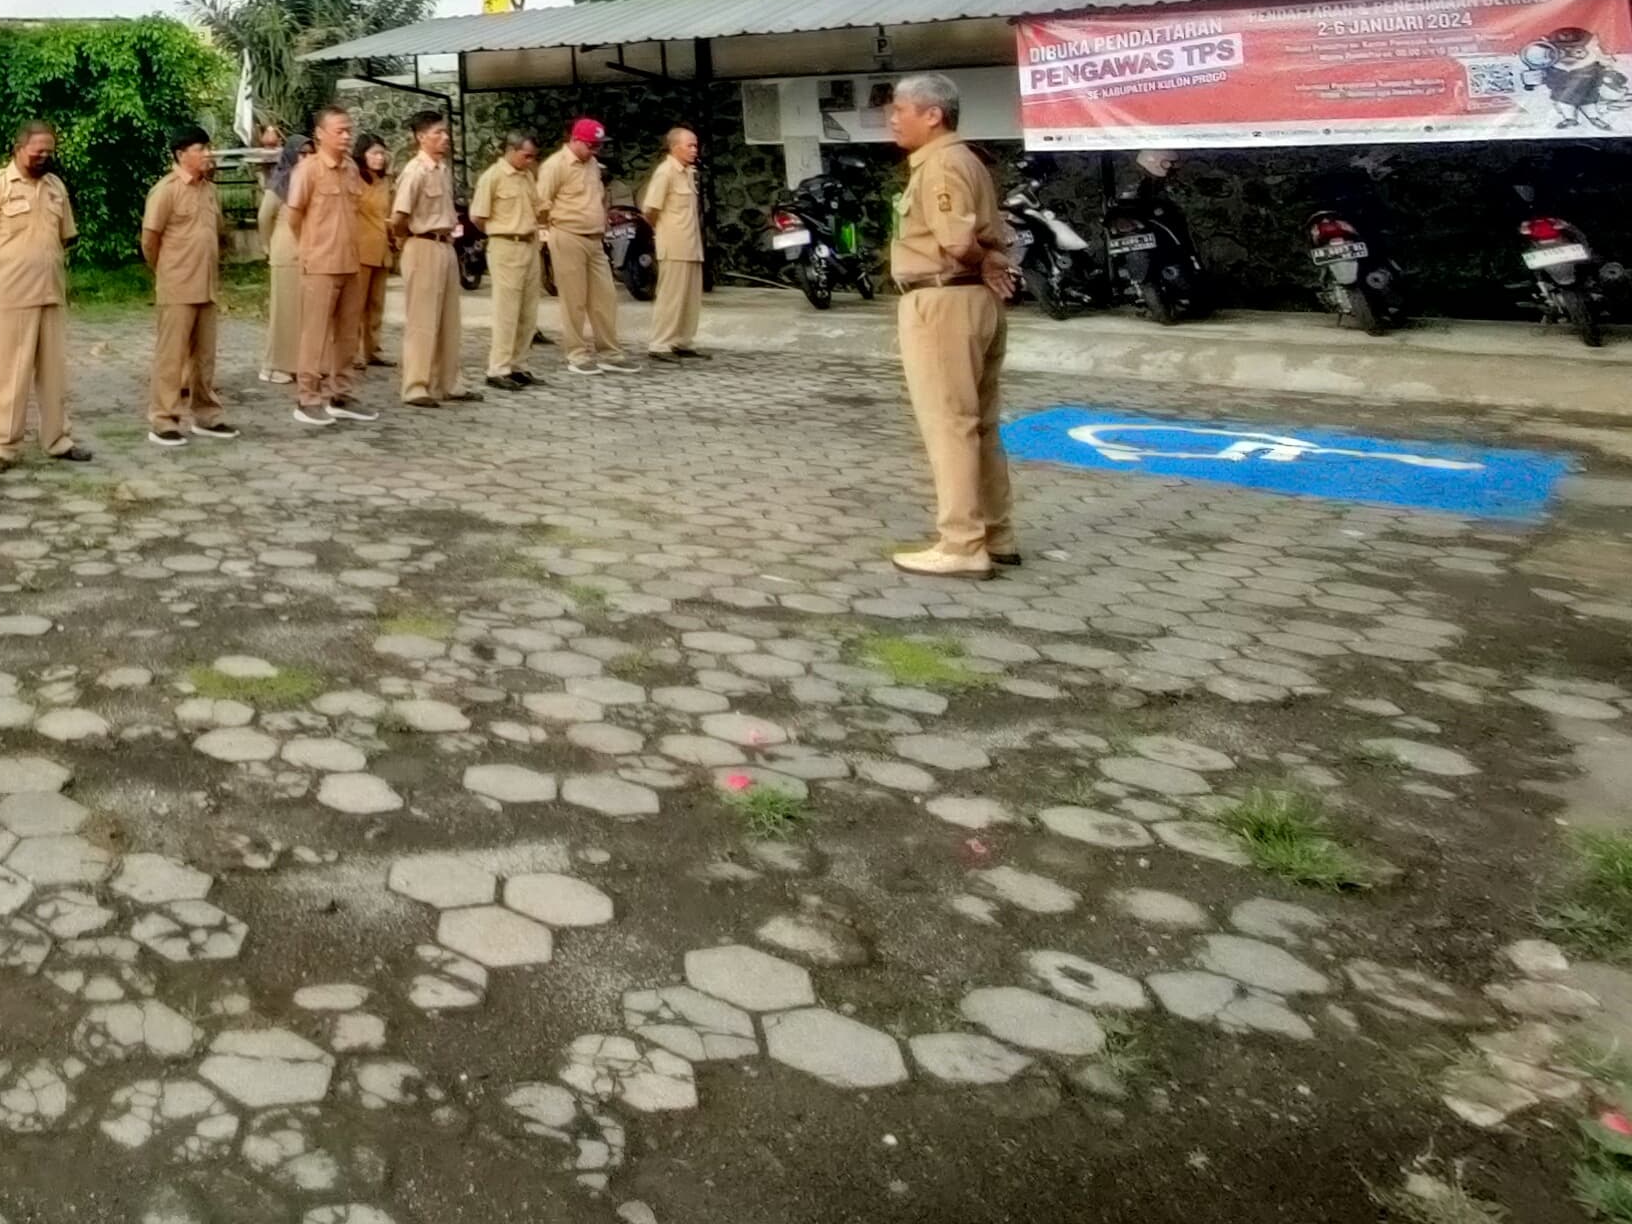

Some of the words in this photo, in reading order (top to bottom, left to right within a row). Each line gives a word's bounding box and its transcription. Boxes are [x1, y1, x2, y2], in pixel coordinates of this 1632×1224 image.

[1029, 39, 1090, 64] DIBUKA
[1094, 17, 1224, 52] PENDAFTARAN
[1318, 19, 1345, 36] 2-6
[1349, 15, 1424, 35] JANUARI
[1428, 11, 1473, 29] 2024
[1030, 49, 1175, 90] PENGAWAS
[1181, 38, 1236, 66] TPS
[1088, 81, 1156, 100] SE-KABUPATEN
[1157, 76, 1191, 91] KULON
[1192, 70, 1226, 86] PROGO
